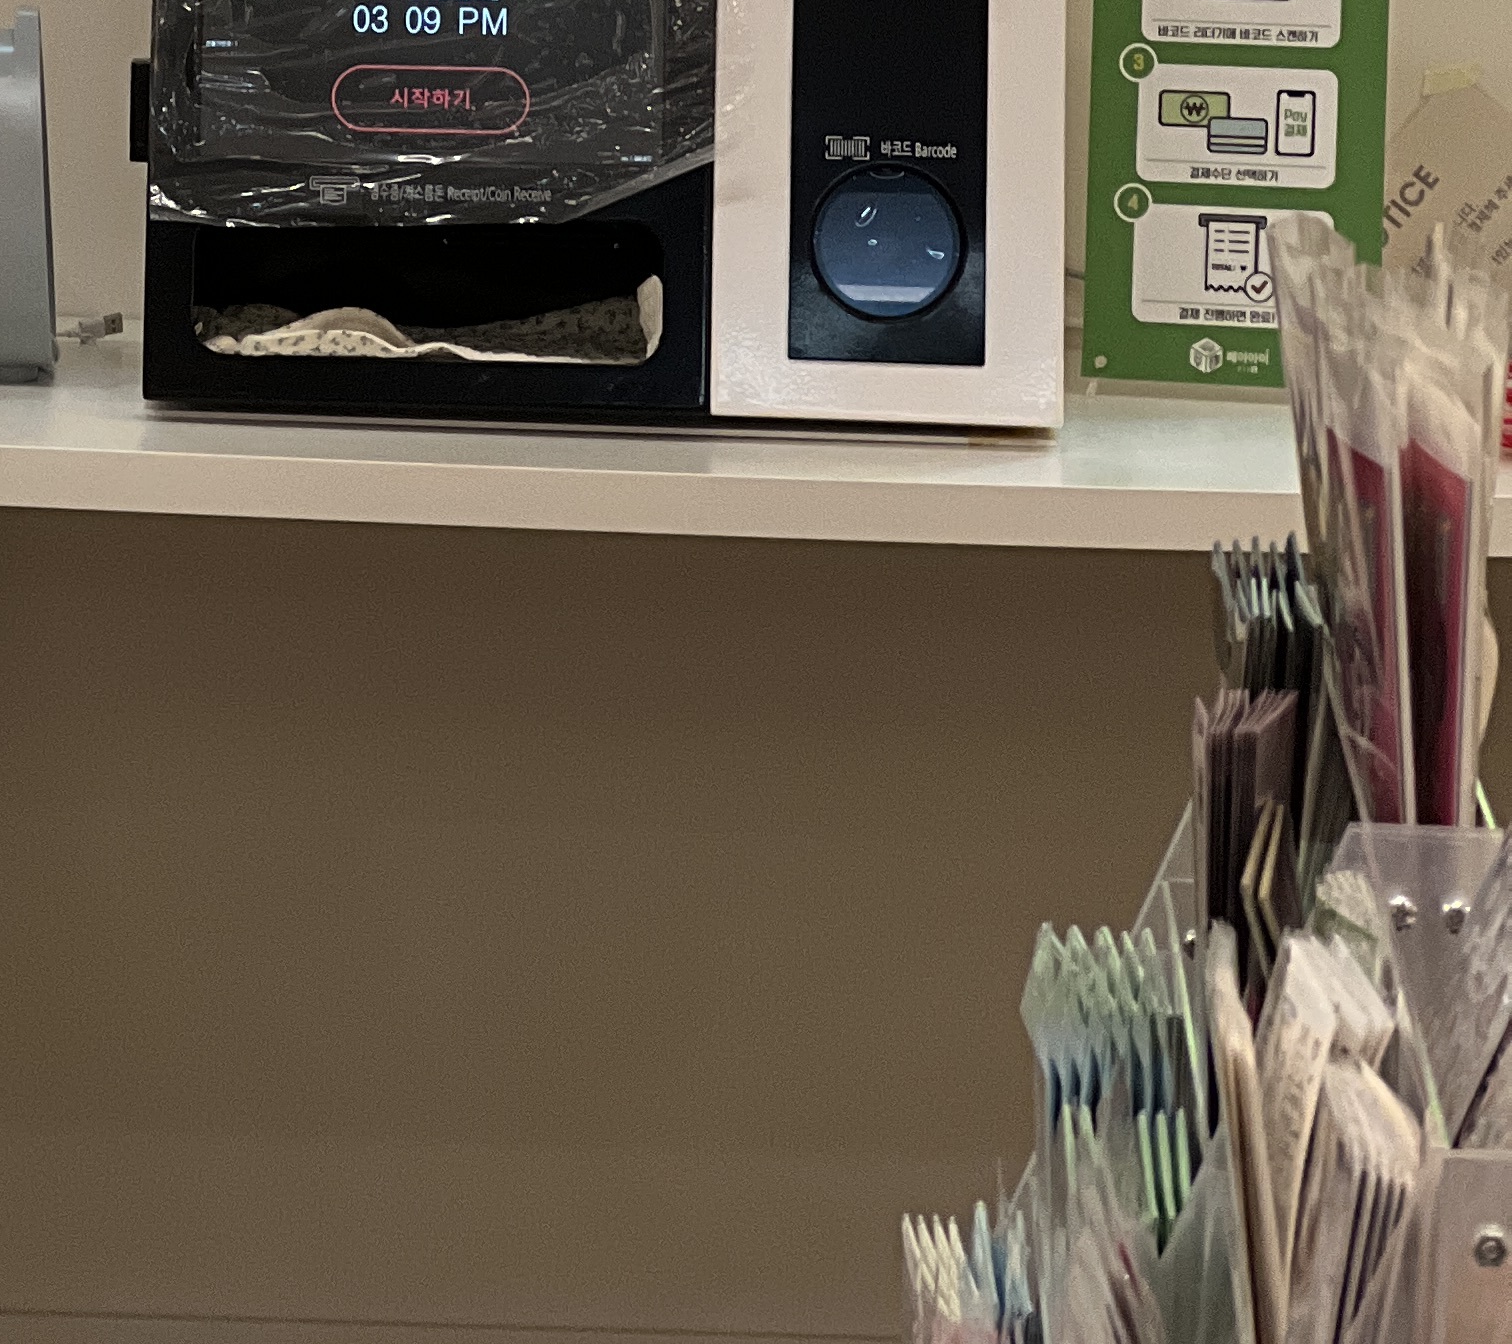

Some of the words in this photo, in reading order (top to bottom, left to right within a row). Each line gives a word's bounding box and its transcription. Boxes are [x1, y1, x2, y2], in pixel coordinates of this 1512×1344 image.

[352, 4, 389, 34] 03
[405, 5, 442, 35] 09
[458, 6, 508, 36] PM
[1158, 25, 1190, 38] 바코드
[1239, 28, 1272, 41] 바코드
[1276, 29, 1319, 43] 스캔하기
[390, 87, 471, 110] 시작하기
[1284, 108, 1308, 123] Pay
[880, 140, 912, 158] 바코드
[915, 142, 957, 159] Barcode
[1189, 167, 1232, 181] 결제수단
[1235, 168, 1279, 183] 선택하기
[513, 185, 552, 203] Receive
